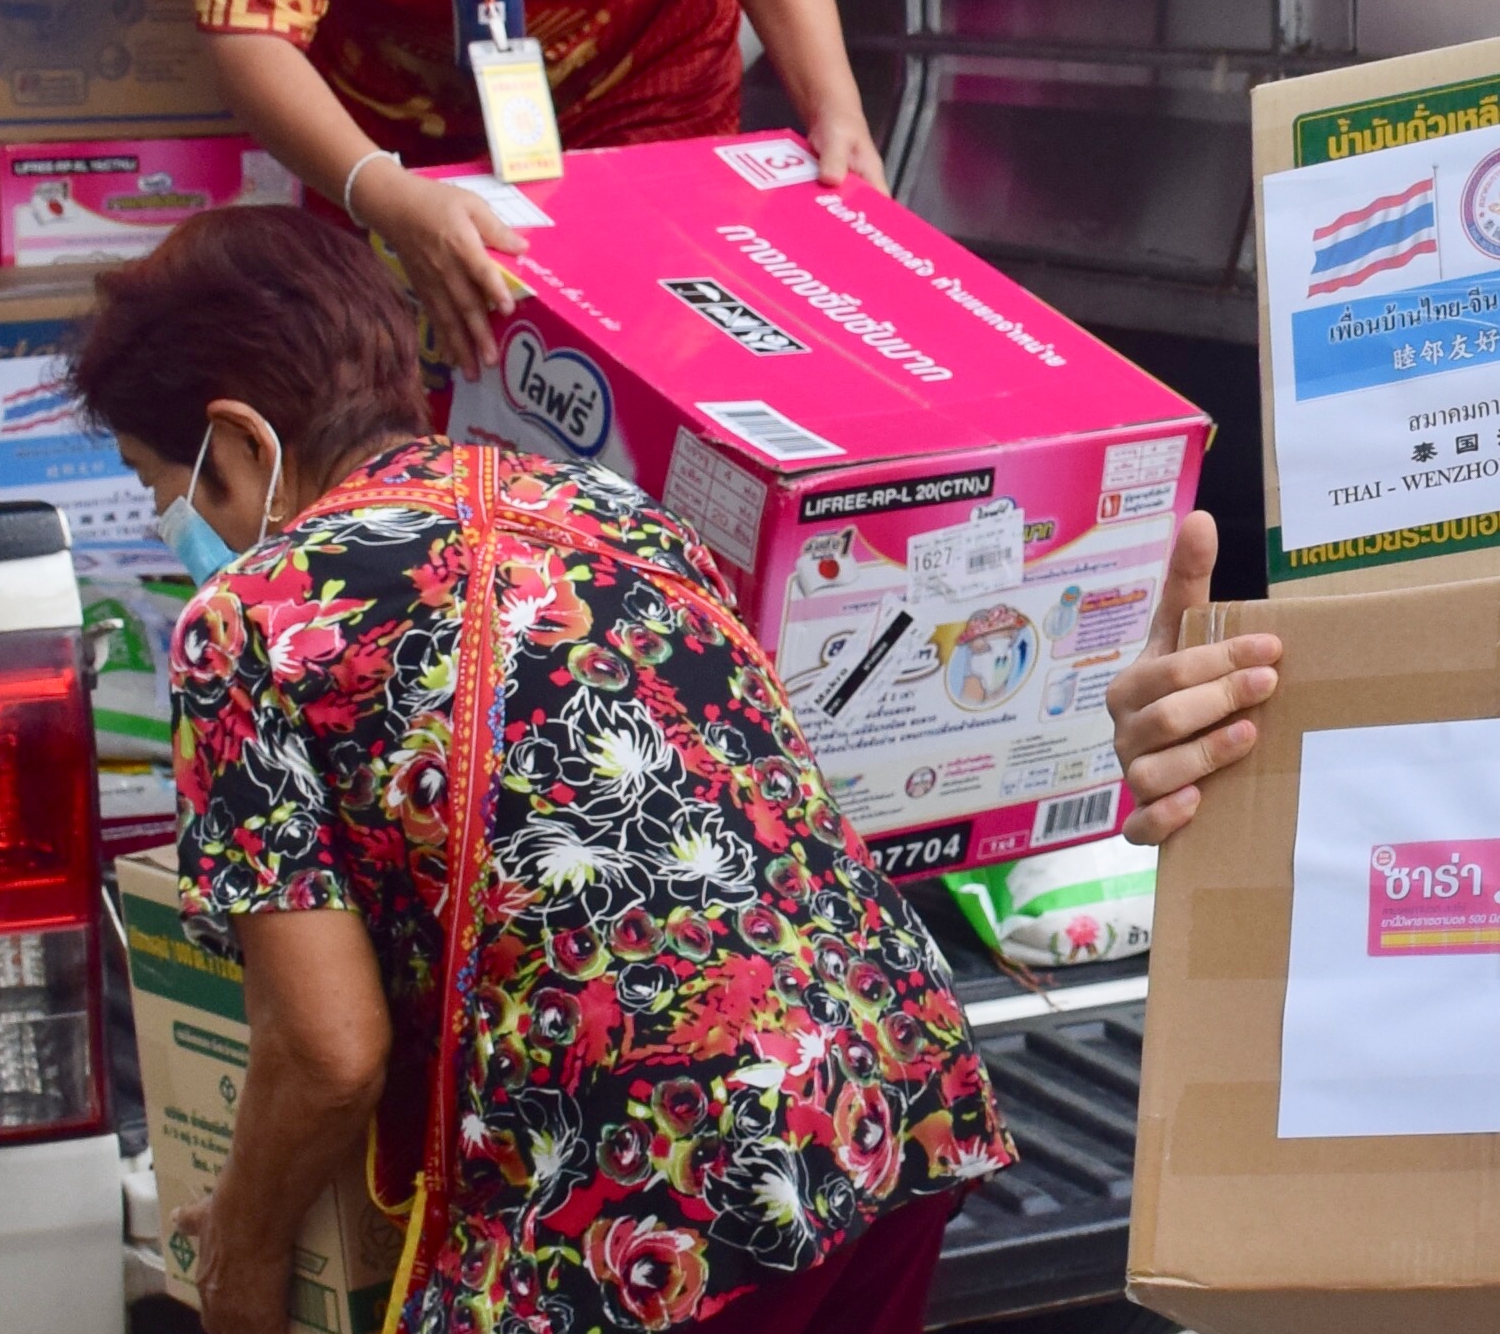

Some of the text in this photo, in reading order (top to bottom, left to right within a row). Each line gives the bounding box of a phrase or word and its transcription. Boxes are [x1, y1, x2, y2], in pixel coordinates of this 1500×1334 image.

[764, 153, 804, 176] 3
[716, 225, 953, 383] กางเกงซึมซับมาก
[1328, 289, 1498, 345] เพื่อนบ้านไทย-จีน
[804, 474, 990, 517] LIFREE-RP-L 20(CTN)J
[1329, 481, 1382, 506] THAI
[912, 546, 954, 572] 1627
[1383, 853, 1483, 900] ซาร่า
